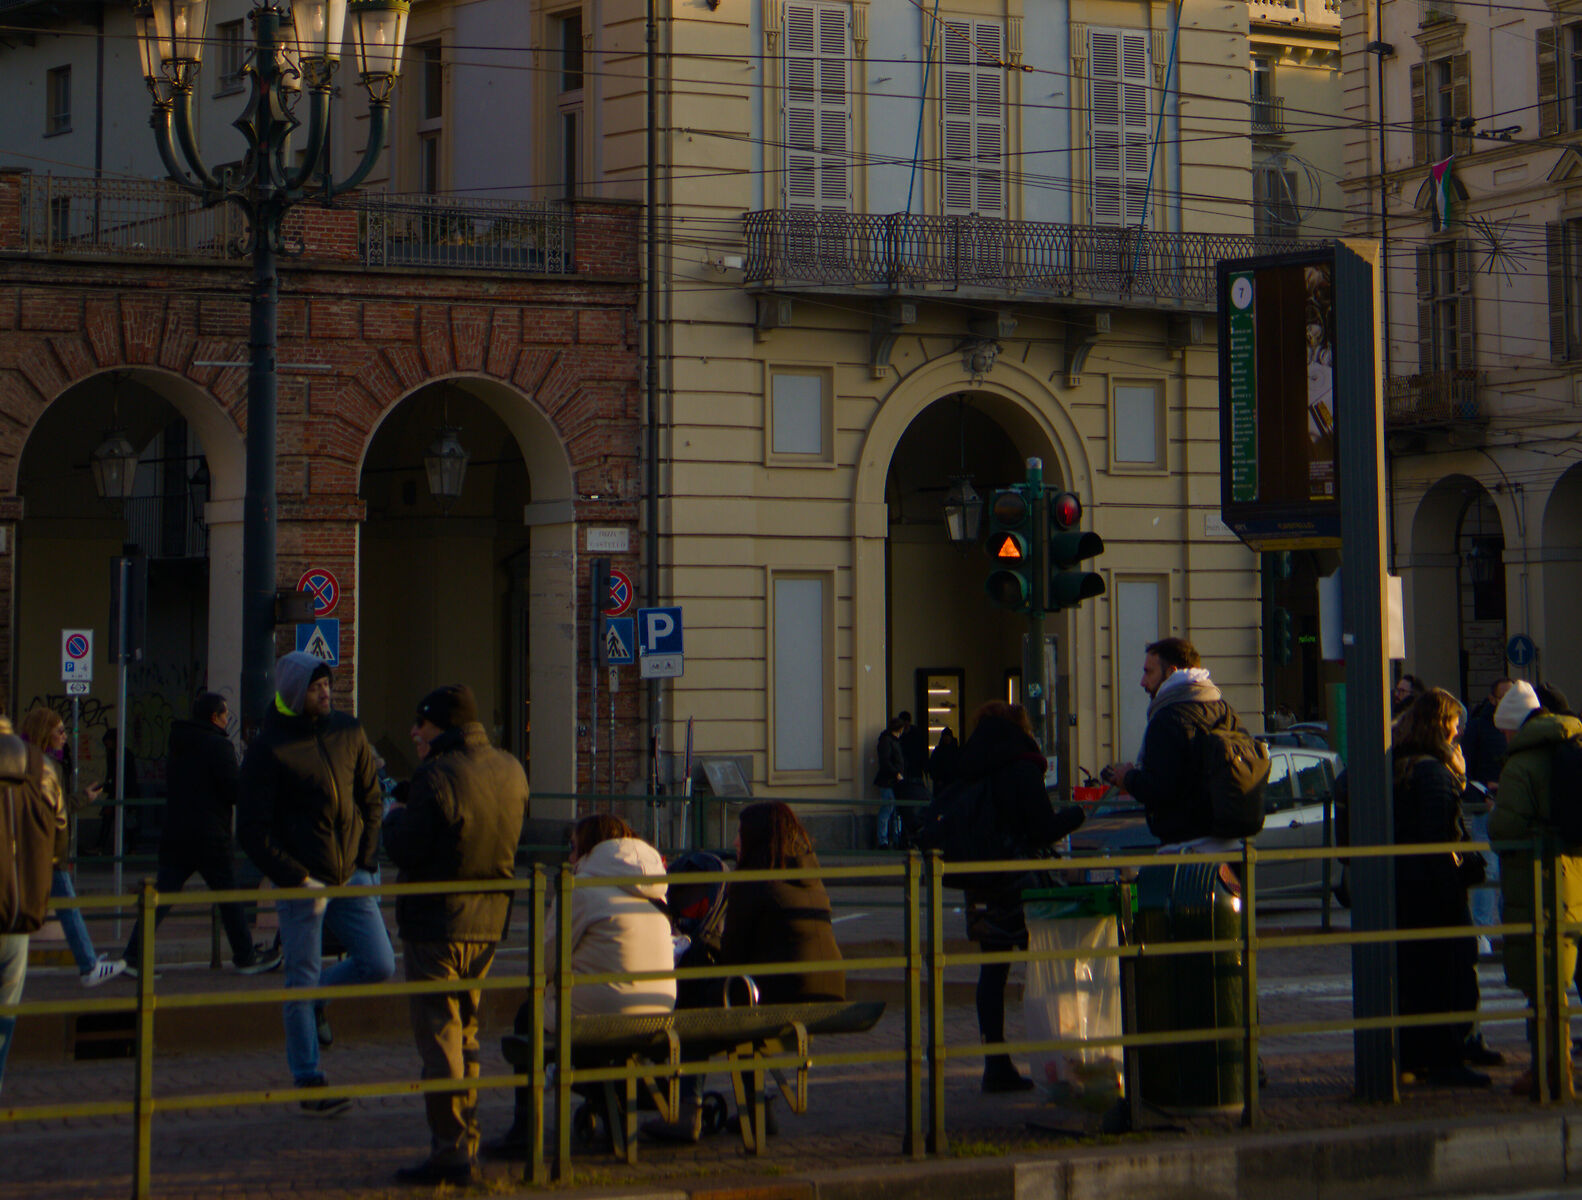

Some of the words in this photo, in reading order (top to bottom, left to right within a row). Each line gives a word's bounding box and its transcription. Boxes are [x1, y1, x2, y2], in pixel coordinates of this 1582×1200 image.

[1238, 287, 1244, 299] 7
[647, 613, 674, 650] P
[67, 663, 74, 672] P
